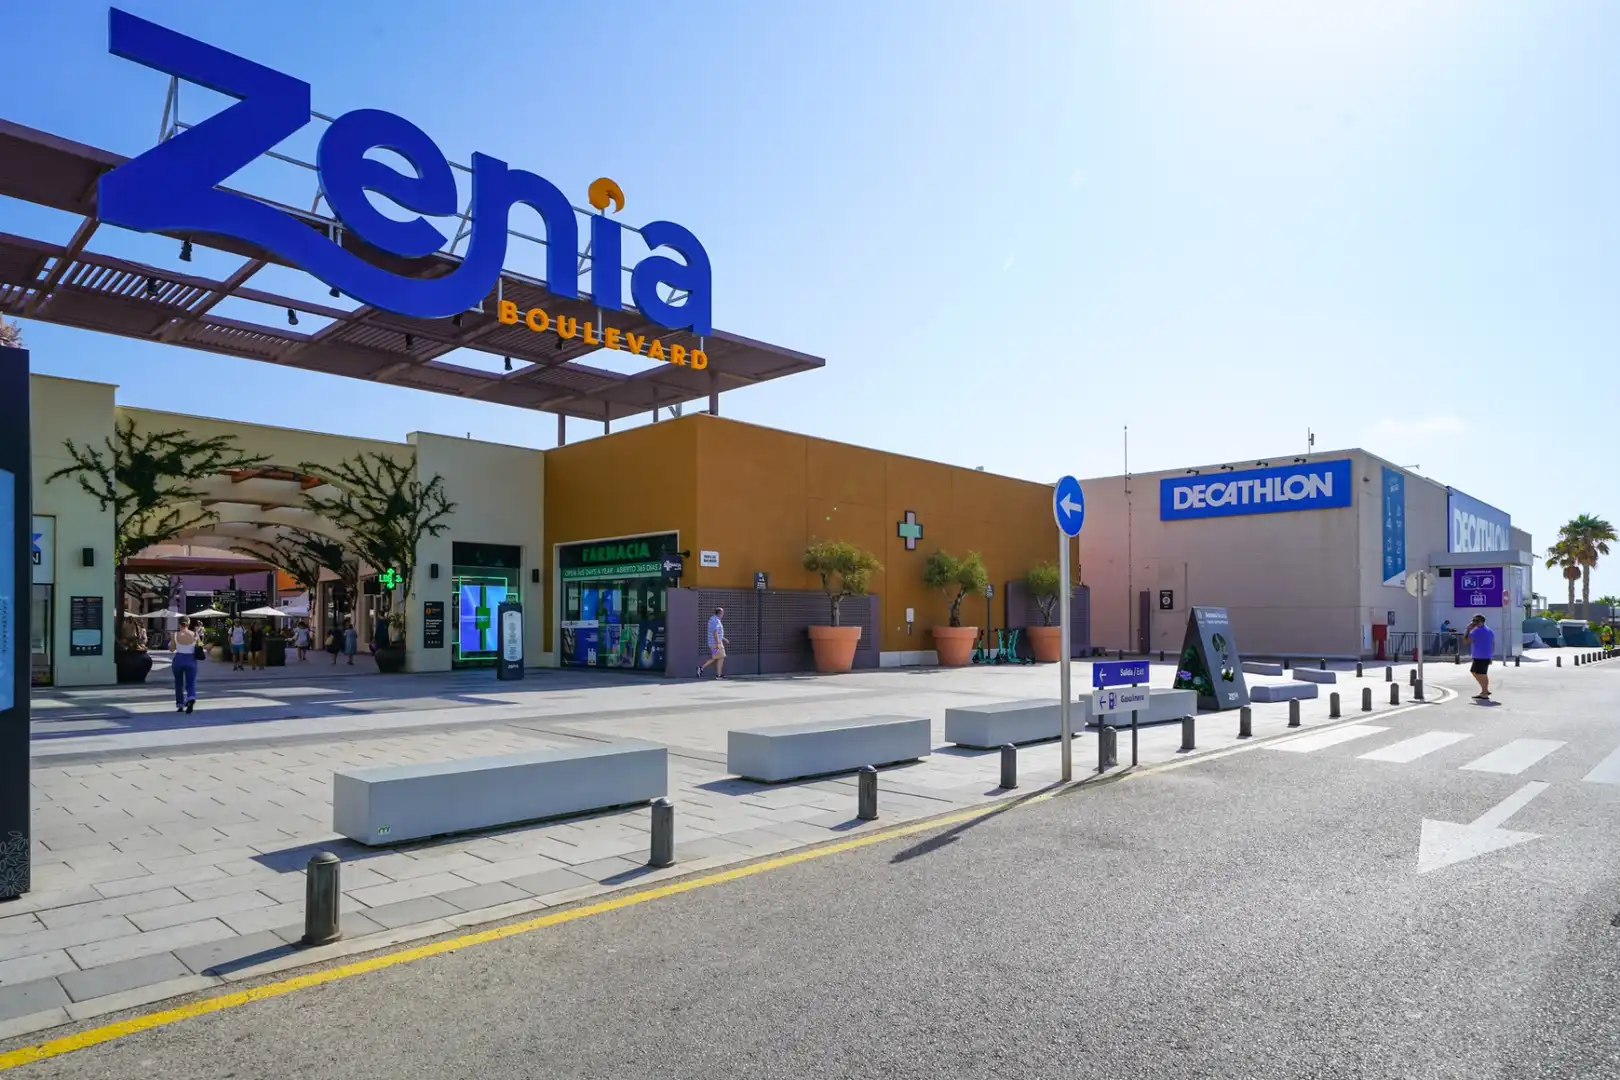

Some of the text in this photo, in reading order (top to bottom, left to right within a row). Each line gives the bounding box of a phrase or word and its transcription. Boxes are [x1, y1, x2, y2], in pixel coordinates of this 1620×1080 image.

[498, 300, 708, 371] BOULEVARD
[1173, 472, 1333, 510] DECATHLON
[1453, 506, 1509, 553] DECATHLON
[582, 542, 650, 562] FARMACIA
[602, 566, 614, 575] YEAR
[636, 563, 646, 572] 365
[1120, 667, 1133, 676] Salida
[1120, 694, 1145, 703] Gasolinera
